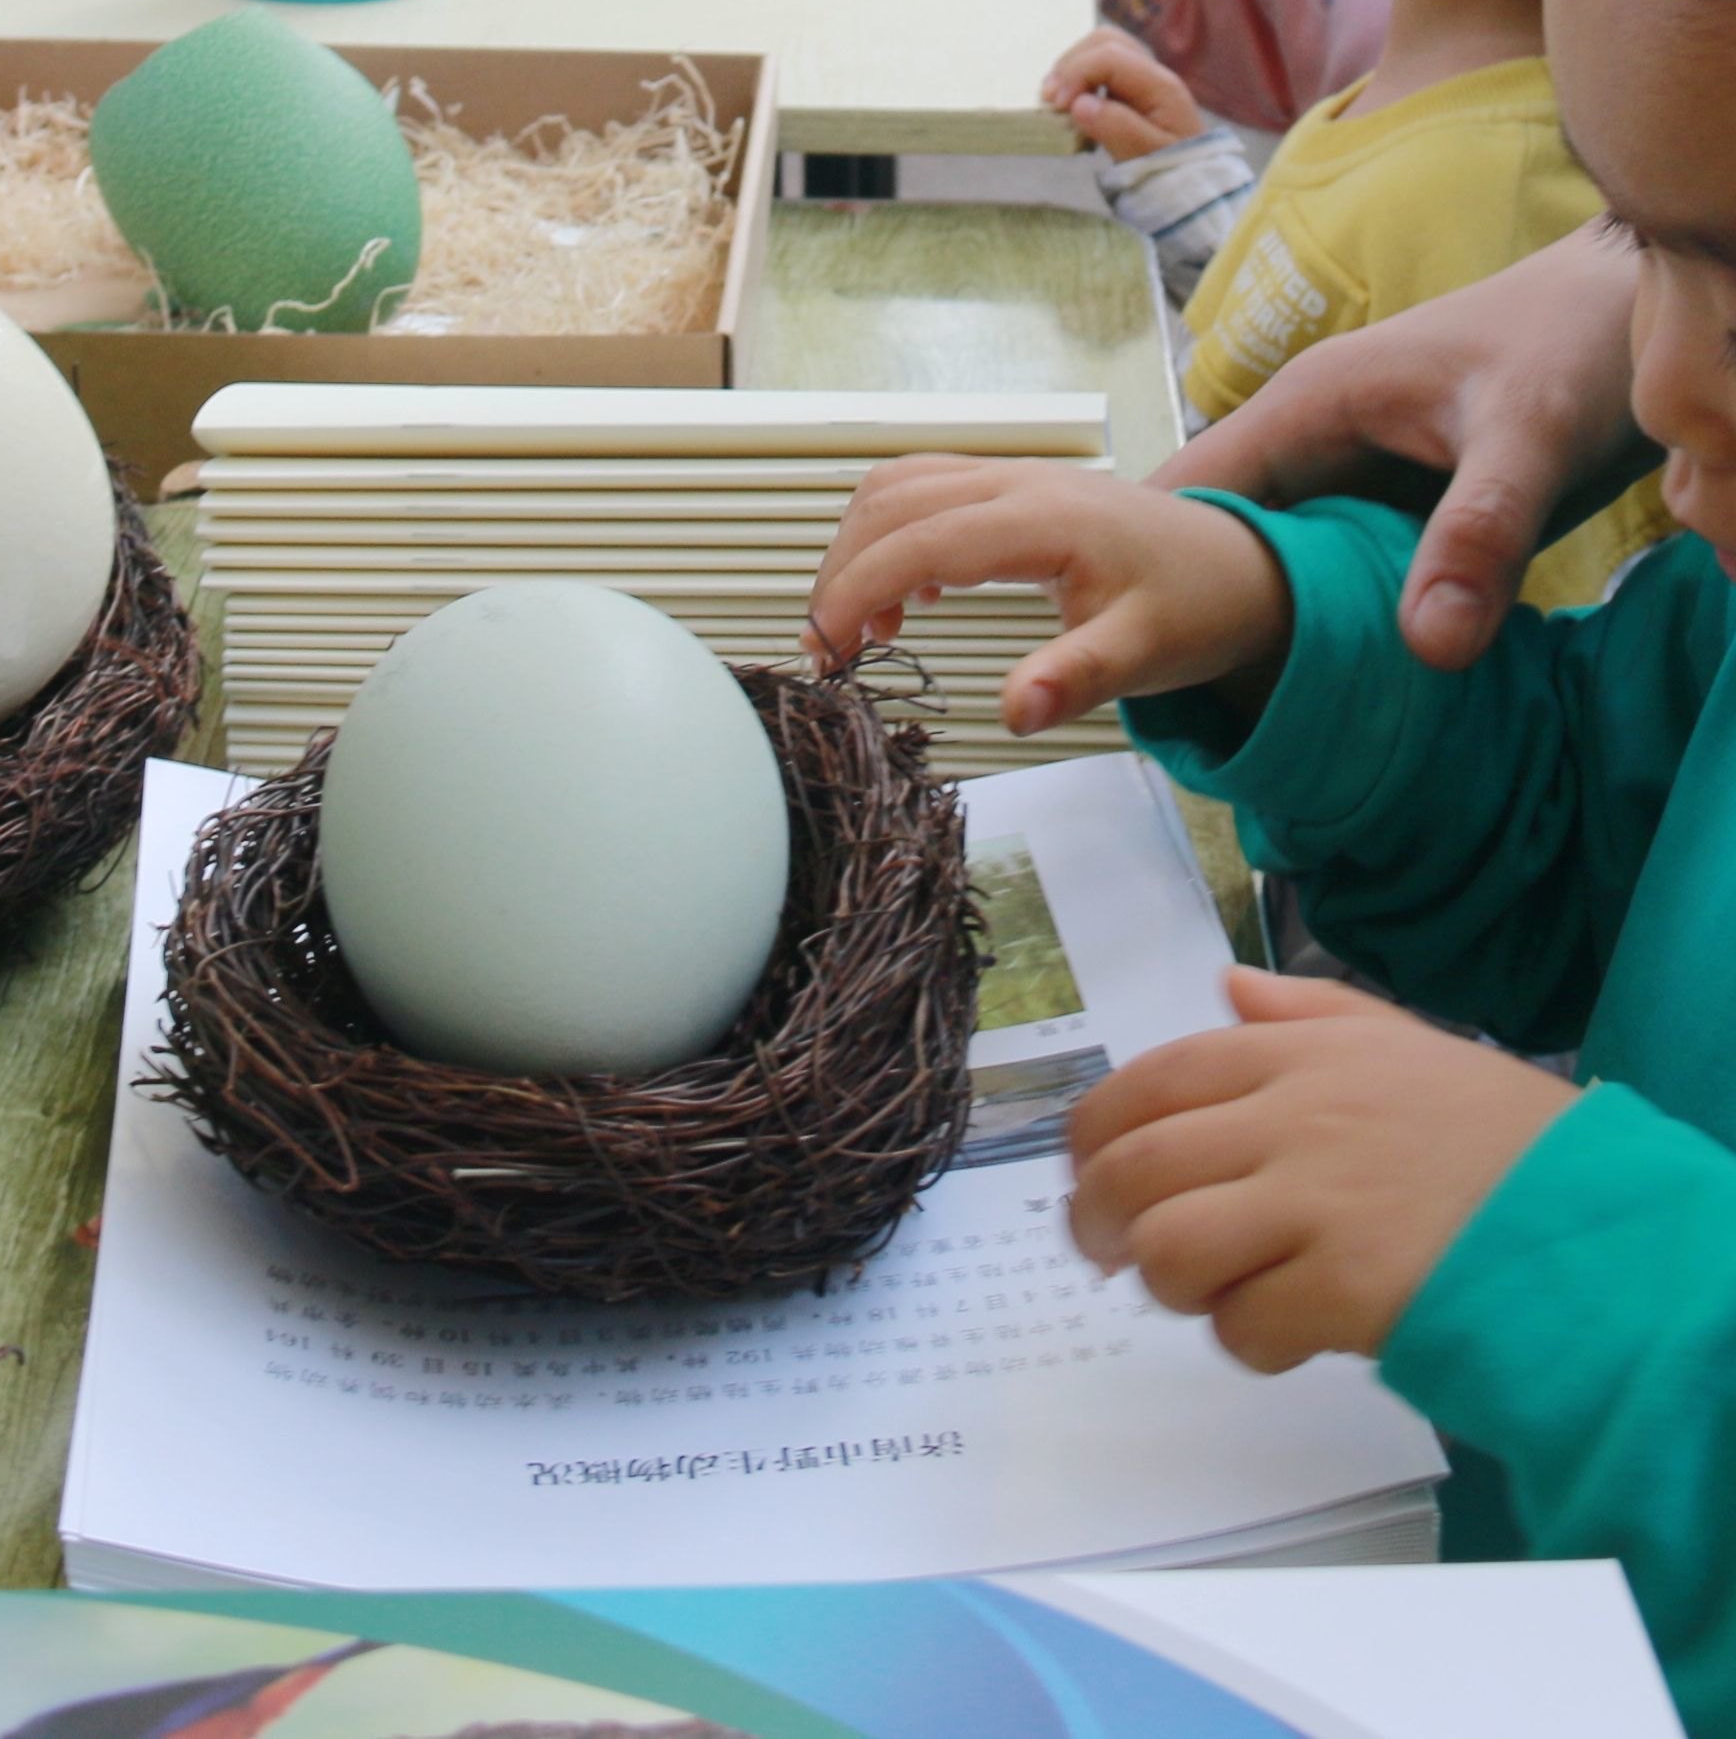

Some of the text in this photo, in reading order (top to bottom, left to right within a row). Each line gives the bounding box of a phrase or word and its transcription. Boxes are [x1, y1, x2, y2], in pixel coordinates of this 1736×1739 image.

[525, 1431, 966, 1487] 济南市野生动物概况
